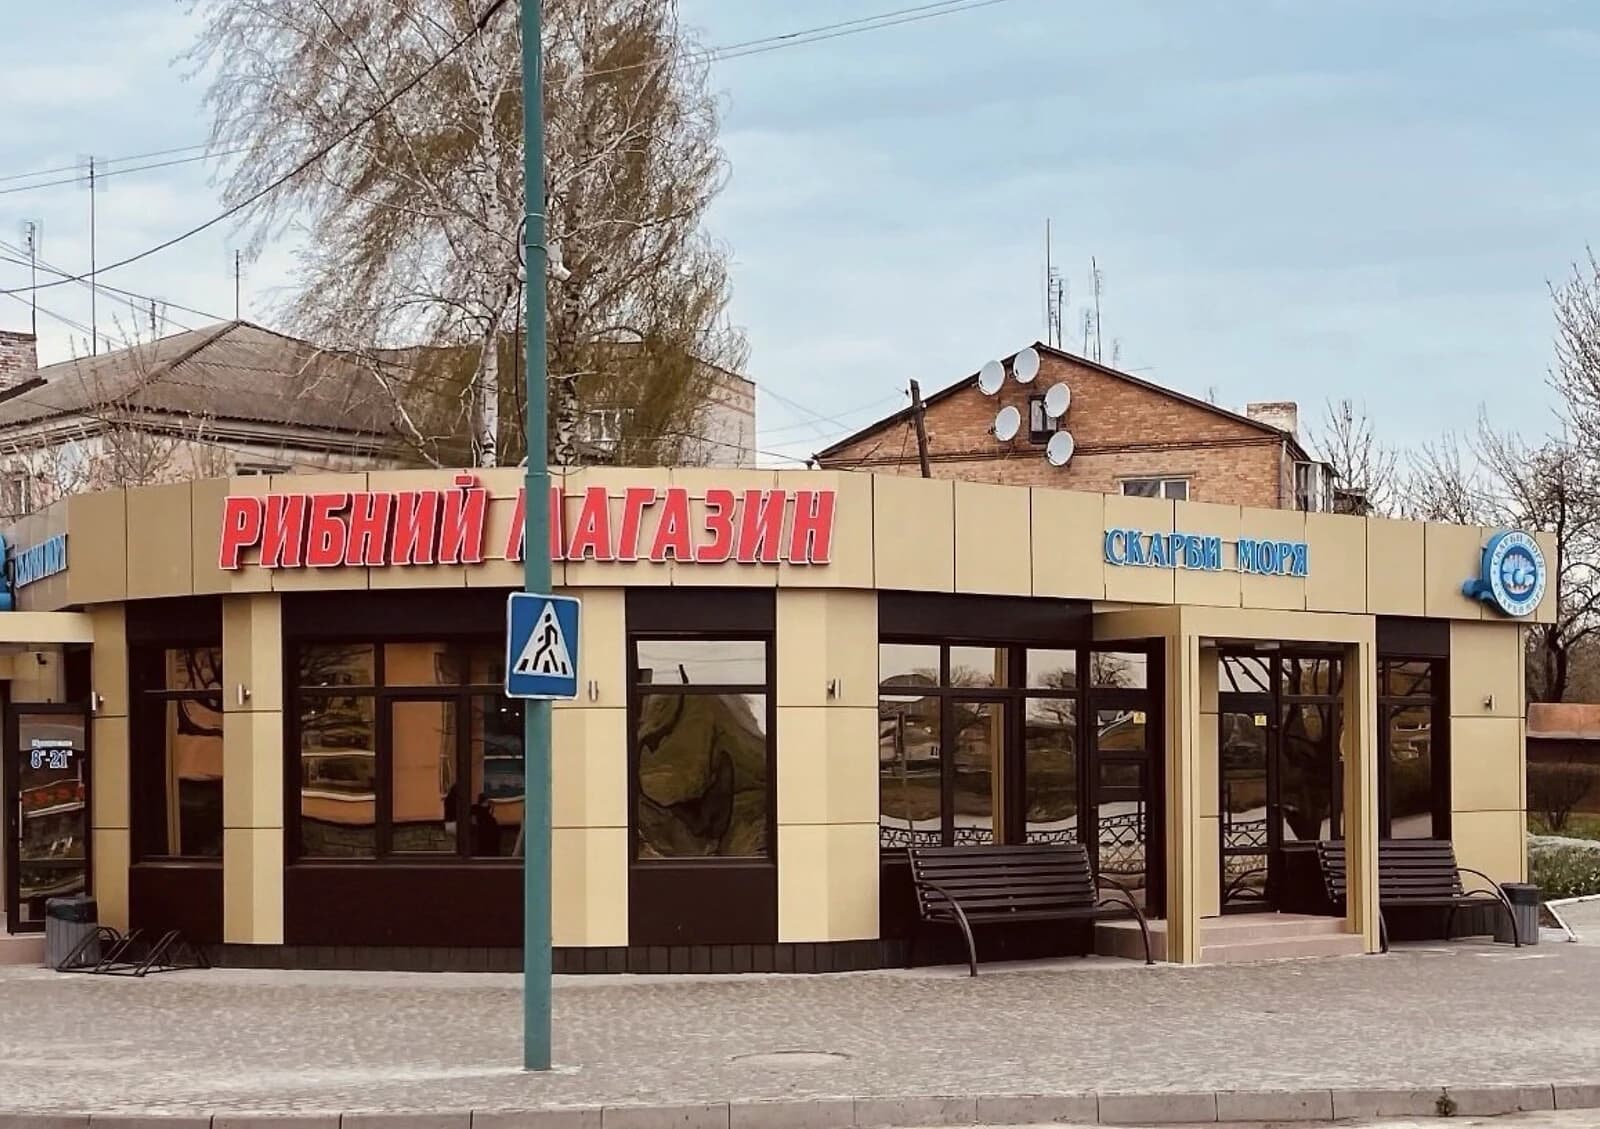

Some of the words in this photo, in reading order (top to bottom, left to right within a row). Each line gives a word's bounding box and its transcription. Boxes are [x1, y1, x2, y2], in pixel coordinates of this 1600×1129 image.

[218, 469, 488, 570] РИБНИЙ
[1104, 527, 1222, 571] СКАРБИ
[1236, 536, 1310, 577] МОРЯ
